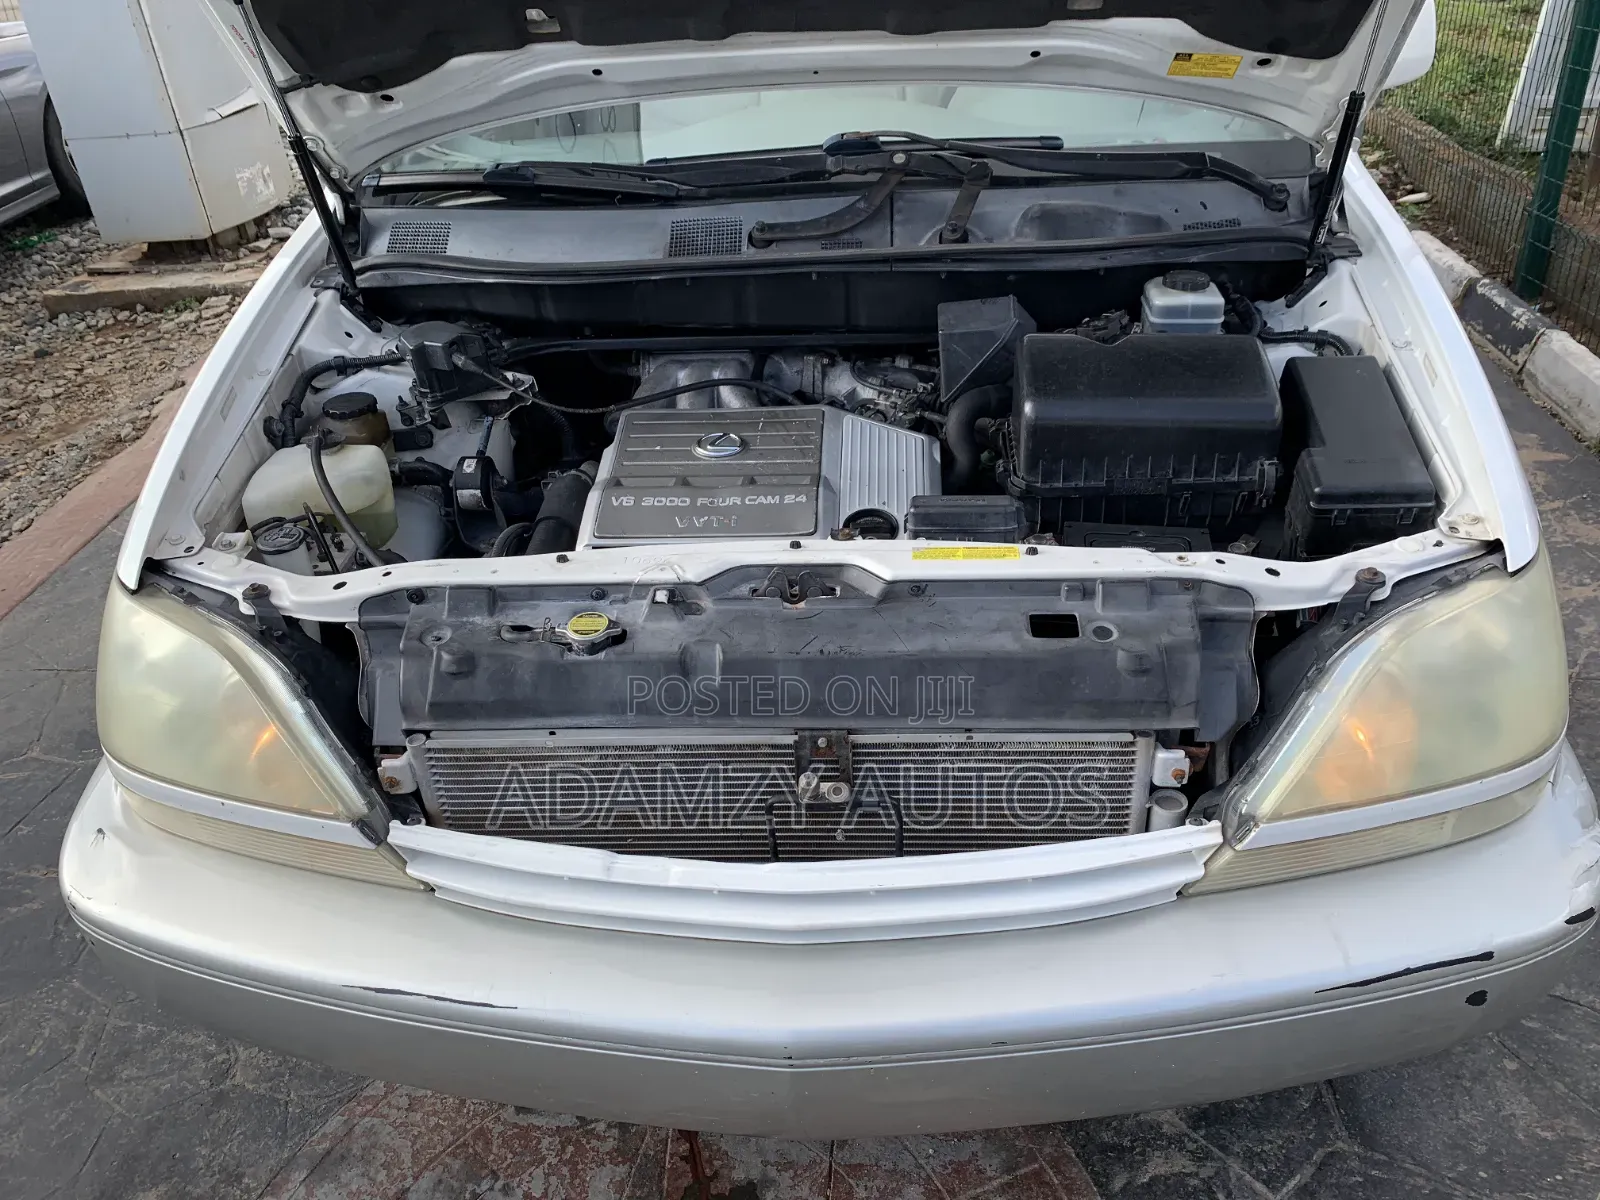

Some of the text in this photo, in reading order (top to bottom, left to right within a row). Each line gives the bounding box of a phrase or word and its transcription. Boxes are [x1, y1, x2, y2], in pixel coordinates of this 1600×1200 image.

[611, 494, 808, 507] V6 3000 FOUR CAM 24
[675, 515, 739, 528] VVT-i
